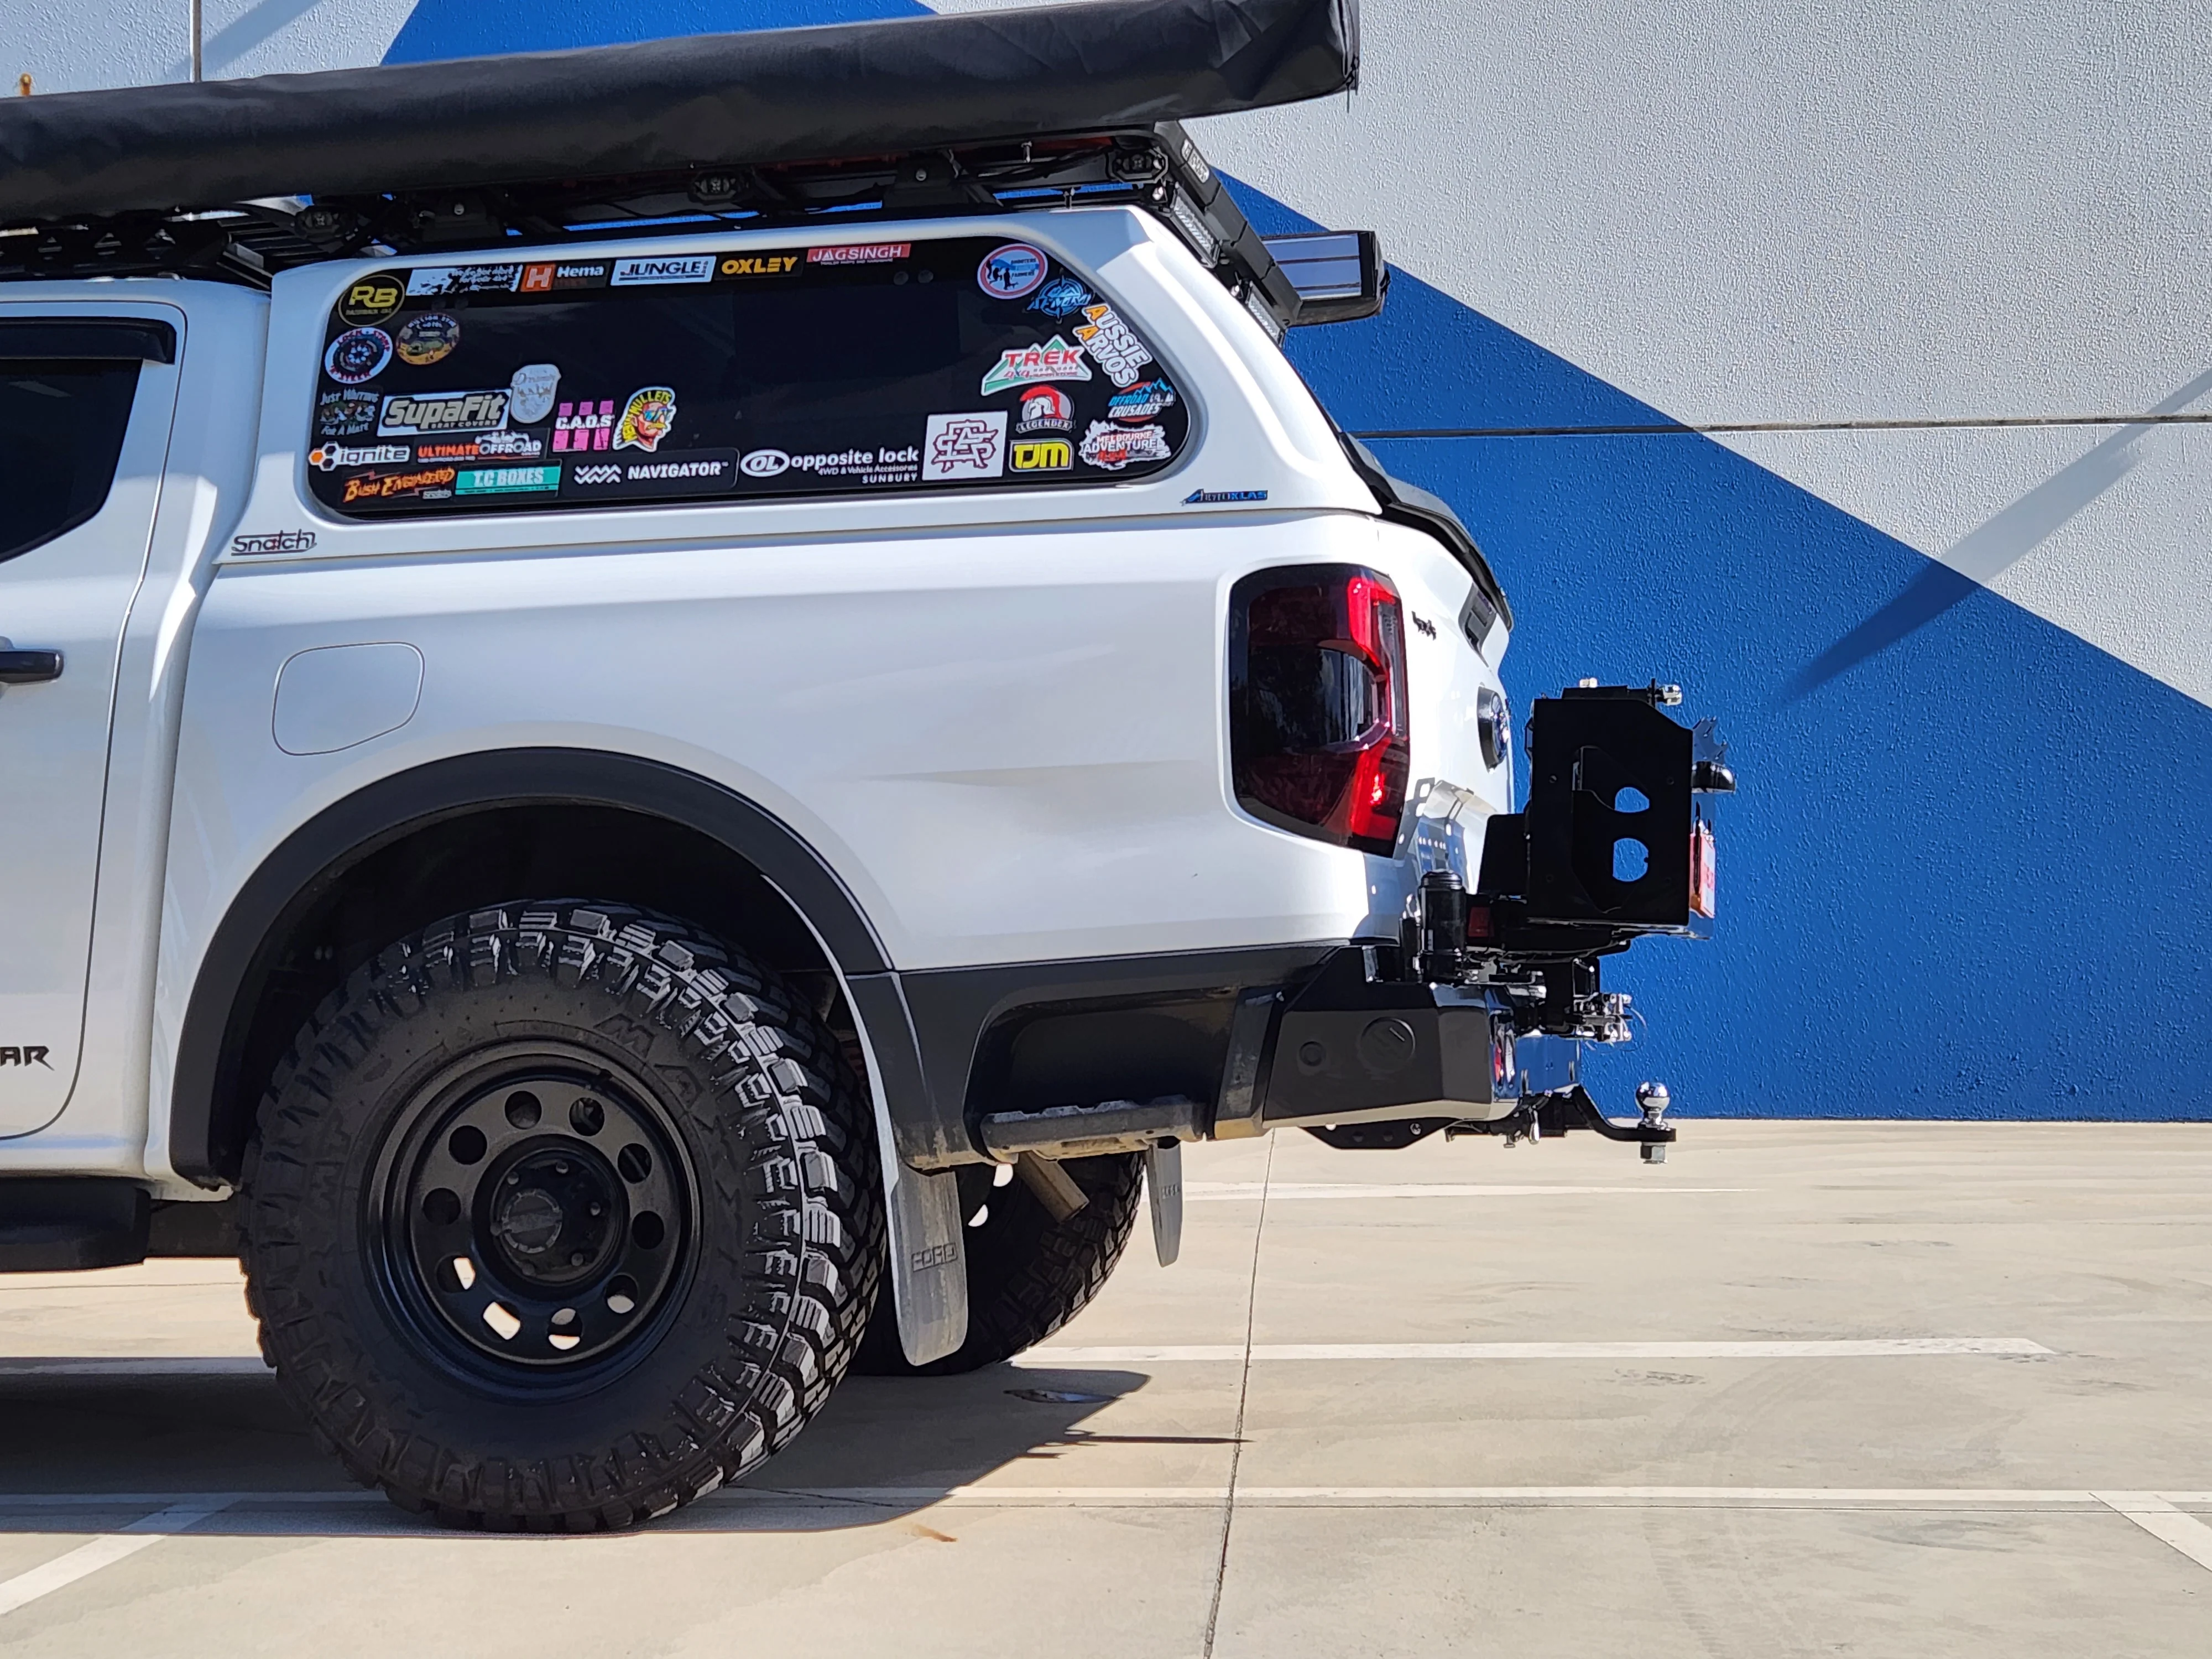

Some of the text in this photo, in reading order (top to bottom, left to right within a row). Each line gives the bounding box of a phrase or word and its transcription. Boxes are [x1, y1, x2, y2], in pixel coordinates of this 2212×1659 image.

[812, 246, 901, 262] JAGSINGH
[556, 265, 604, 278] Hema
[620, 261, 701, 276] JUNGLE
[722, 257, 798, 274] OXLEY
[528, 267, 551, 288] H
[348, 286, 398, 307] RB
[1086, 306, 1150, 367] AUSSIE
[1005, 350, 1079, 367] TREK
[1076, 326, 1136, 385] ARVOS
[1108, 393, 1150, 406] OFFROAD
[385, 394, 506, 429] SupaFit
[1108, 403, 1162, 418] CRUSADES
[1097, 431, 1152, 444] MELBOURNE
[340, 448, 406, 463] ignite
[418, 444, 479, 458] ULTIMATE
[791, 448, 873, 471] opposite
[878, 446, 919, 463] lock
[1014, 443, 1069, 468] TJM
[497, 467, 544, 486] BOXES
[862, 474, 918, 483] SUNBURY
[0, 1046, 55, 1071] AR
